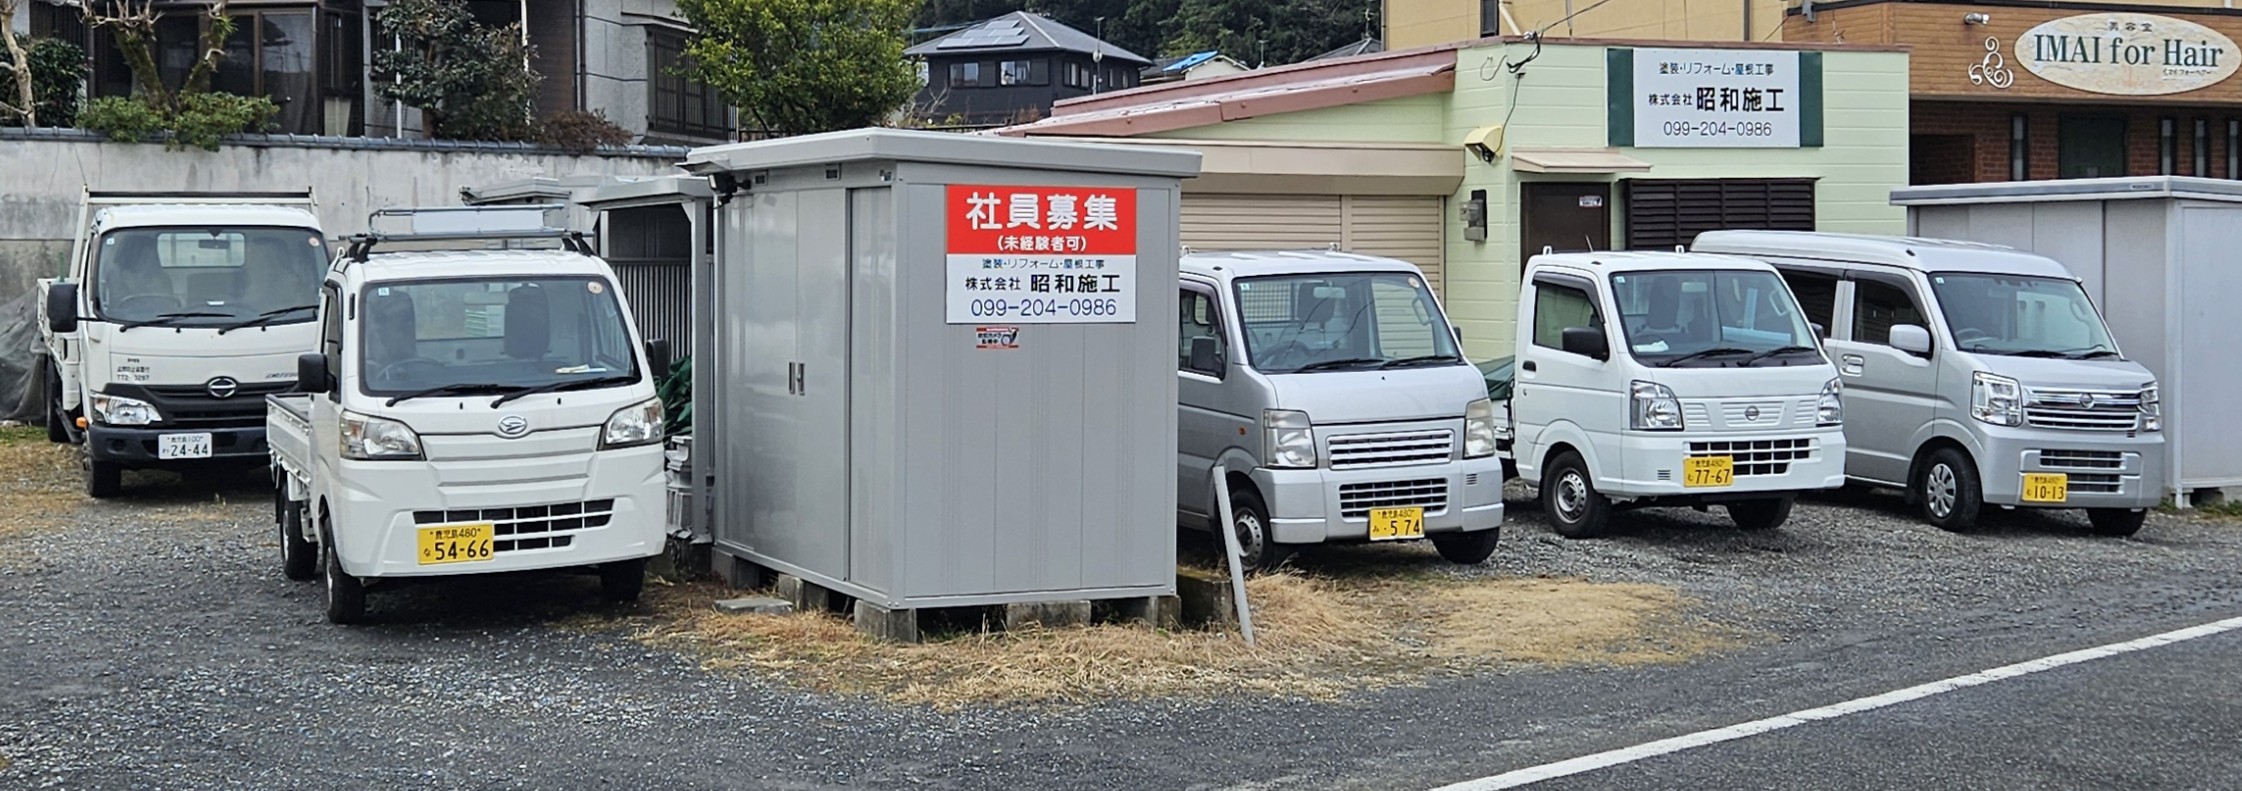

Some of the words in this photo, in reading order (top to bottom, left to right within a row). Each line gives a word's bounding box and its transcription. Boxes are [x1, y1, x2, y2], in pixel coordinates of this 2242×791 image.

[2034, 34, 2100, 64] IMAI
[2109, 37, 2155, 65] for
[2162, 39, 2224, 67] Hair
[1648, 93, 1693, 106] 株式会社
[1696, 87, 1784, 112] 昭和施工
[1663, 121, 1772, 136] 099-204-0986
[965, 191, 1118, 231] 社員募集
[997, 235, 1087, 251] （未経験者可）
[965, 276, 1021, 291] 株式会社
[1030, 274, 1120, 293] 昭和施工
[971, 299, 1117, 316] 099-204-0986
[171, 443, 208, 457] 24-44
[1695, 468, 1730, 484] 77-67
[2034, 485, 2064, 500] 10-13
[435, 539, 489, 560] 54-66
